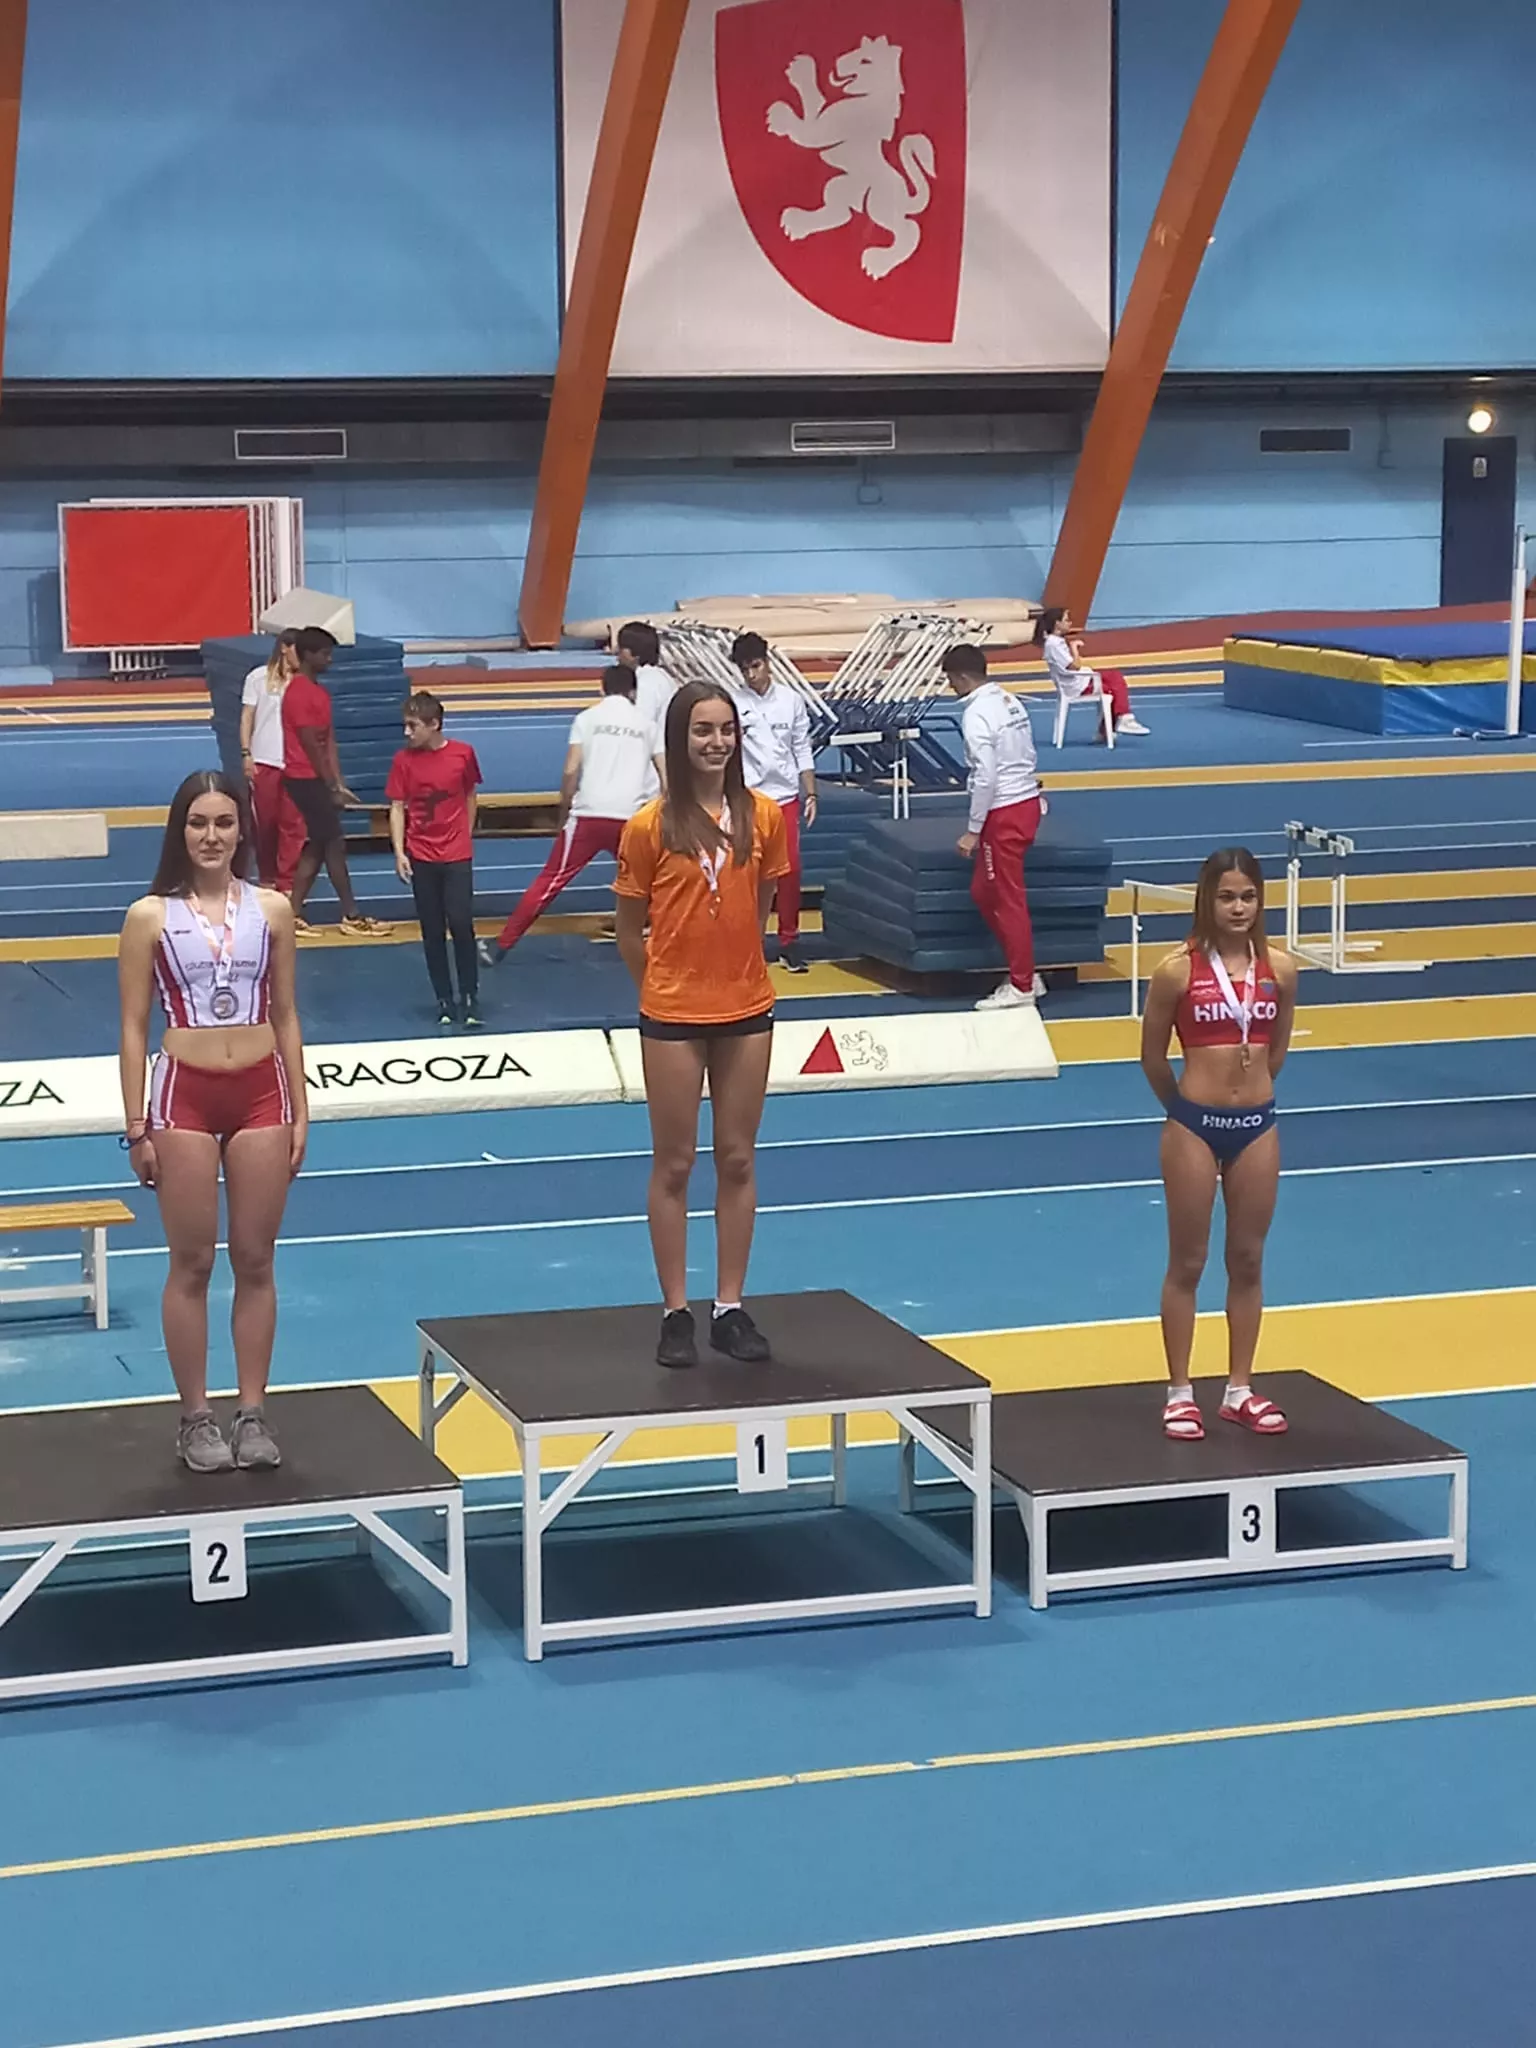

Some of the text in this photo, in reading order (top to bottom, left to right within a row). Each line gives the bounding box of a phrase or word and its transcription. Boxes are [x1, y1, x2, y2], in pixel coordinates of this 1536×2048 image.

[1194, 1001, 1277, 1022] HINCO
[1202, 1114, 1263, 1129] HINACO
[754, 1434, 765, 1474] 1
[1242, 1503, 1261, 1543] 3
[207, 1542, 230, 1584] 2
